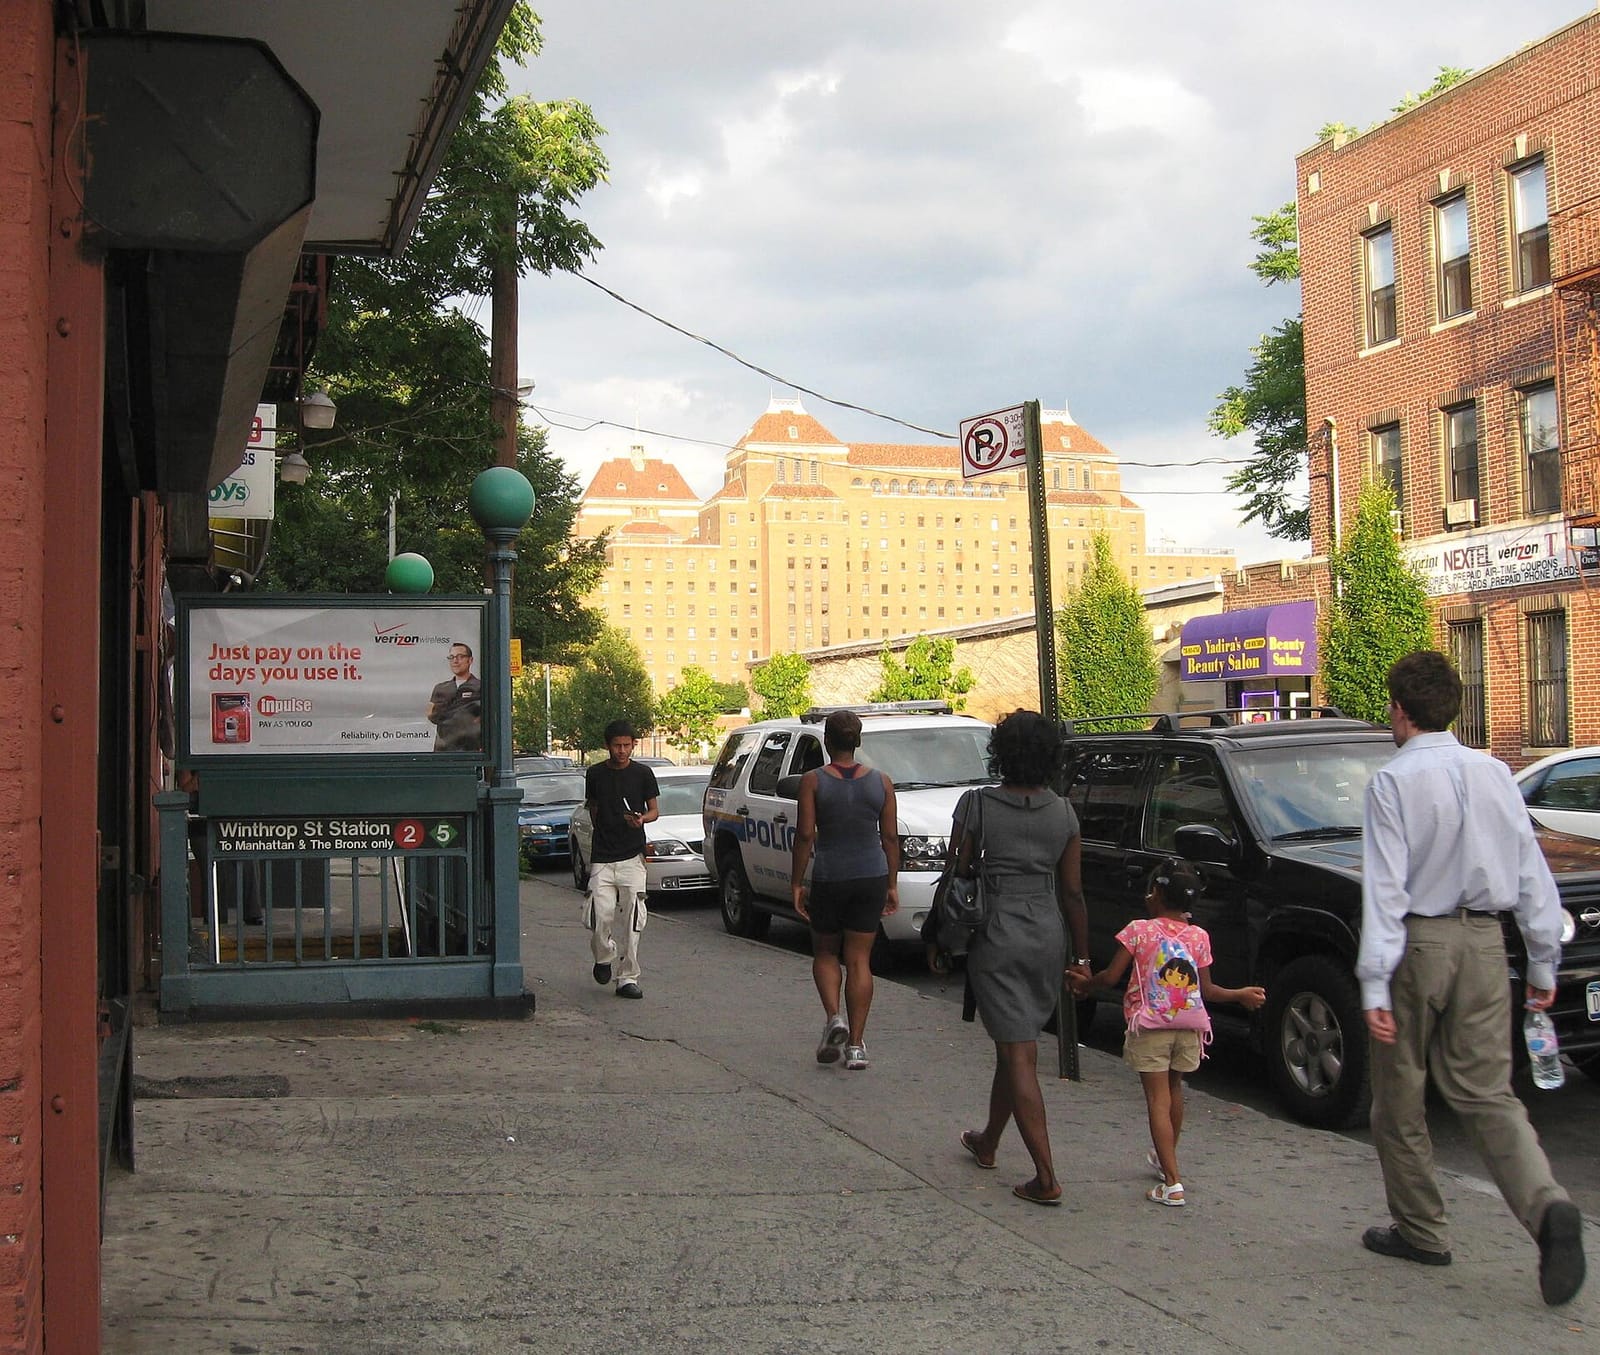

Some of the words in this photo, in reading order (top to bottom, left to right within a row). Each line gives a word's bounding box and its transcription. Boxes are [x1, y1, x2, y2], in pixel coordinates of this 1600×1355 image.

[1444, 544, 1493, 571] NEXTEL
[1498, 543, 1539, 561] verizon
[1453, 569, 1481, 581] PREPAID
[1486, 563, 1517, 577] AIR-TIME
[1520, 558, 1558, 572] COUPONS
[1491, 573, 1521, 587] PREPAID
[1524, 569, 1550, 580] PHONE
[1553, 566, 1580, 578] CARDS
[374, 632, 419, 646] verizon
[420, 633, 450, 644] wireless
[1204, 637, 1241, 655] Yadira's
[1269, 637, 1306, 655] Beauty
[208, 643, 250, 661] Just
[255, 645, 292, 664] pay
[297, 647, 323, 660] on
[328, 642, 362, 660] the
[1272, 652, 1303, 666] Salon
[208, 663, 256, 685] days
[260, 667, 298, 685] you
[303, 667, 339, 680] use
[343, 663, 362, 680] it.
[1187, 657, 1225, 678] Beauty
[1228, 653, 1260, 671] Salon
[260, 698, 312, 713] inpulse
[341, 731, 382, 740] Reliability.
[382, 731, 394, 739] On
[395, 730, 431, 739] Demand.
[219, 821, 298, 840] Winthrop
[303, 821, 323, 837] St
[329, 821, 390, 836] Station
[403, 825, 416, 842] 2
[436, 824, 450, 842] 5
[746, 818, 801, 853] POLIC
[219, 840, 232, 851] To
[235, 840, 295, 850] Manhattan
[298, 839, 306, 850] &
[310, 839, 331, 850] The
[335, 839, 368, 849] Bronx
[371, 838, 394, 850] only
